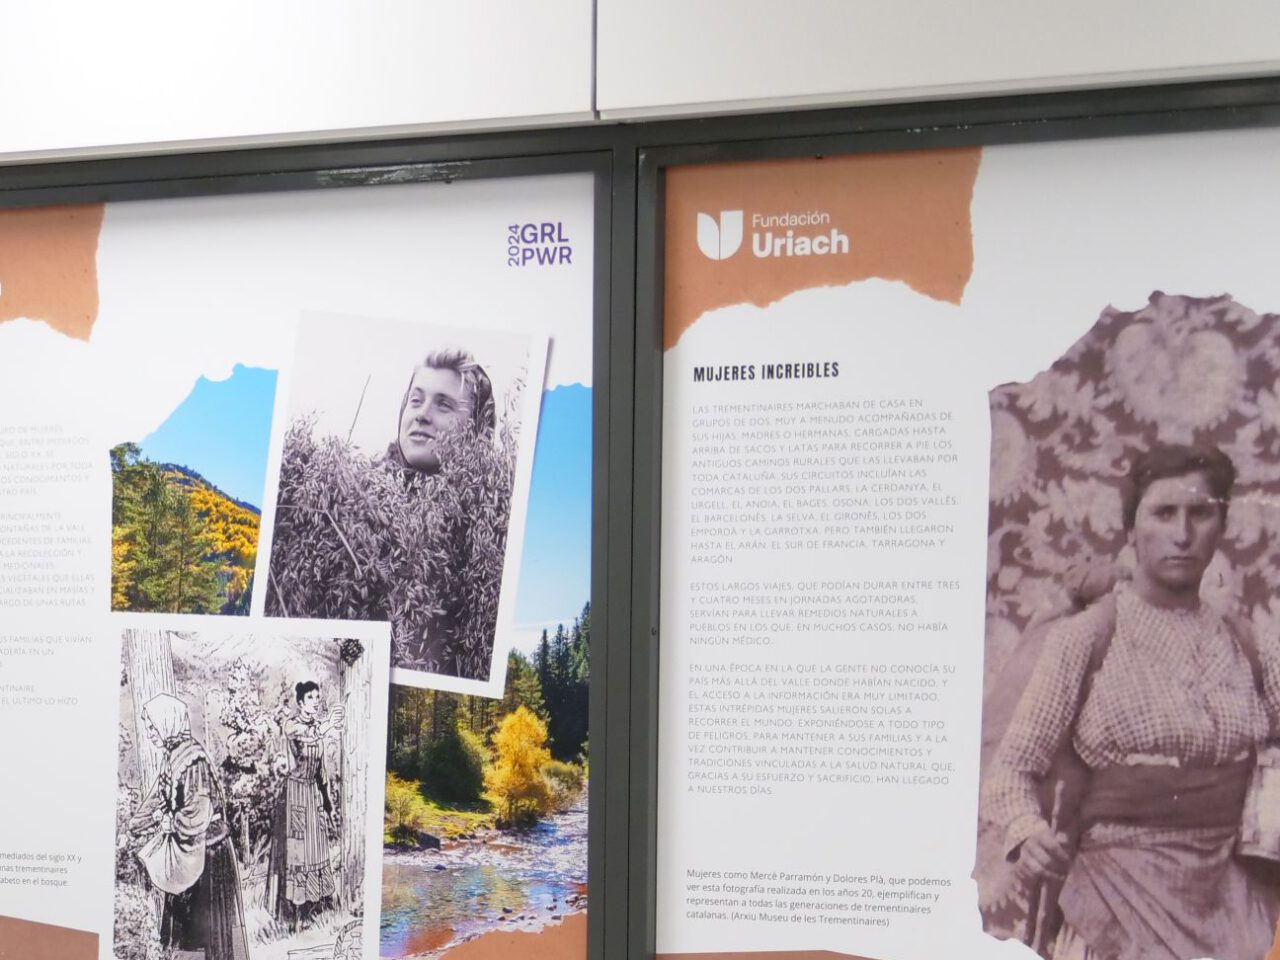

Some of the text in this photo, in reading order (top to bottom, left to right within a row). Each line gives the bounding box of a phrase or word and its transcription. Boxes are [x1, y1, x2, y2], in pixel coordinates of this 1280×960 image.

[753, 211, 830, 228] Fundación
[521, 222, 569, 244] GRL
[508, 224, 520, 267] 2024
[753, 228, 849, 258] Uriach
[522, 246, 572, 266] PWR
[693, 362, 840, 382] MUJERES INCREIBLES
[713, 402, 793, 413] TREMENTINAIRES
[0, 851, 34, 860] mediados
[14, 864, 68, 873] trementinaires
[0, 876, 20, 884] abeto
[686, 869, 721, 881] Mujeres
[723, 872, 748, 880] como
[779, 872, 824, 882] Parramón
[832, 873, 868, 883] Dolores
[888, 877, 906, 887] que
[907, 876, 951, 888] podemos
[701, 883, 720, 893] esta
[766, 885, 807, 895] realizada
[821, 887, 835, 896] los
[837, 888, 859, 897] años
[860, 888, 875, 899] 20,
[876, 889, 932, 902] ejemplifican
[686, 896, 739, 909] representan
[748, 898, 773, 908] todas
[774, 899, 788, 908] las
[789, 900, 848, 913] generaciones
[864, 902, 931, 913] trementinaires
[730, 911, 757, 923] (Arxiu
[758, 912, 789, 922] Museu
[803, 914, 816, 923] les
[819, 914, 890, 927] Trementinaires)
